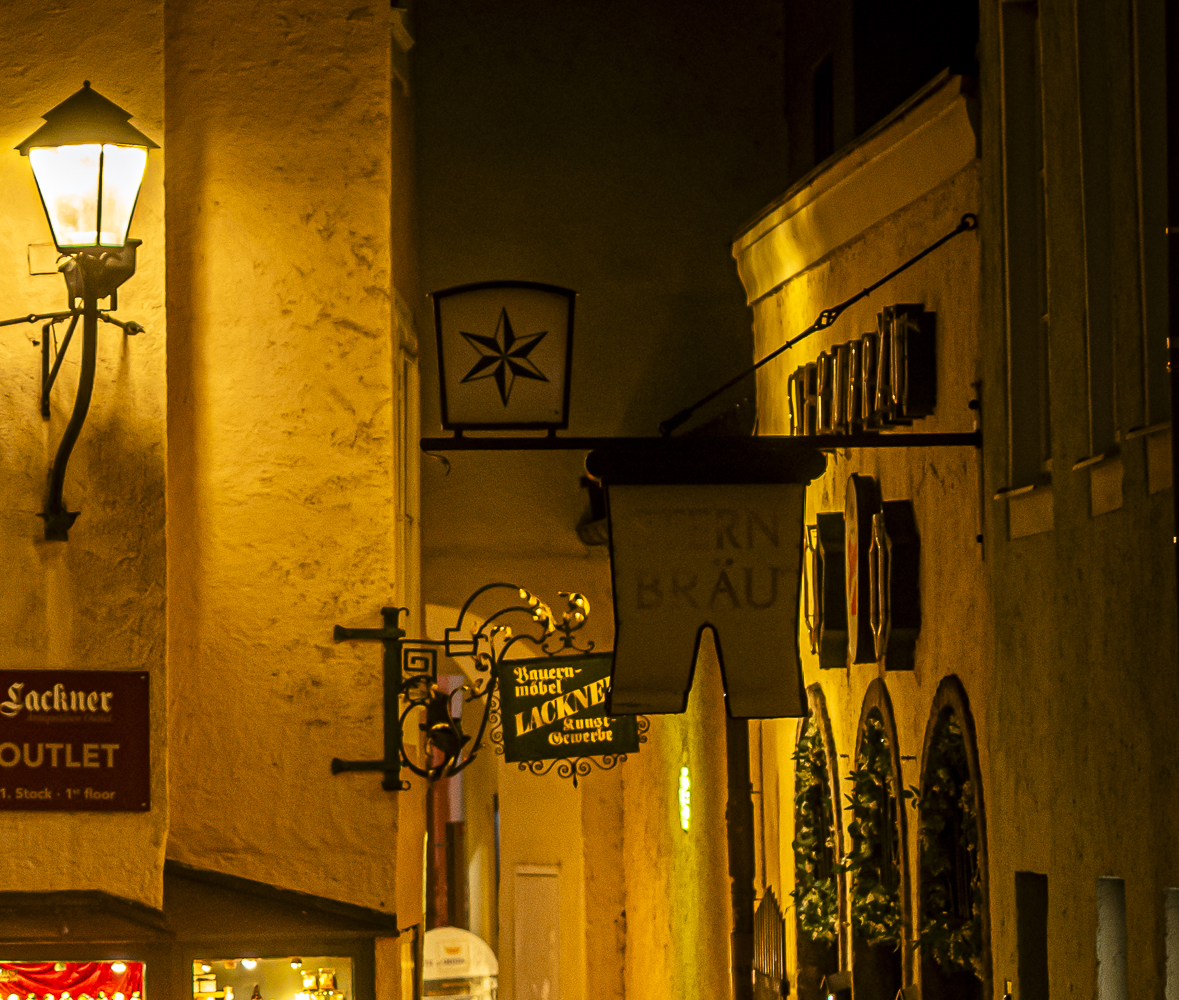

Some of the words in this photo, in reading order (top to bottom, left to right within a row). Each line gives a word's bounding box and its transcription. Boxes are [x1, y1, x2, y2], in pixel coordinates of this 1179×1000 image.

[636, 558, 781, 610] BRÄU
[513, 666, 583, 684] Bauern-
[515, 679, 564, 697] möbel
[0, 682, 114, 717] Lackner
[514, 675, 612, 737] LACKNE
[548, 728, 614, 746] Gewerbe
[0, 787, 12, 799] 1.
[15, 787, 52, 800] Stock
[84, 787, 116, 800] floor
